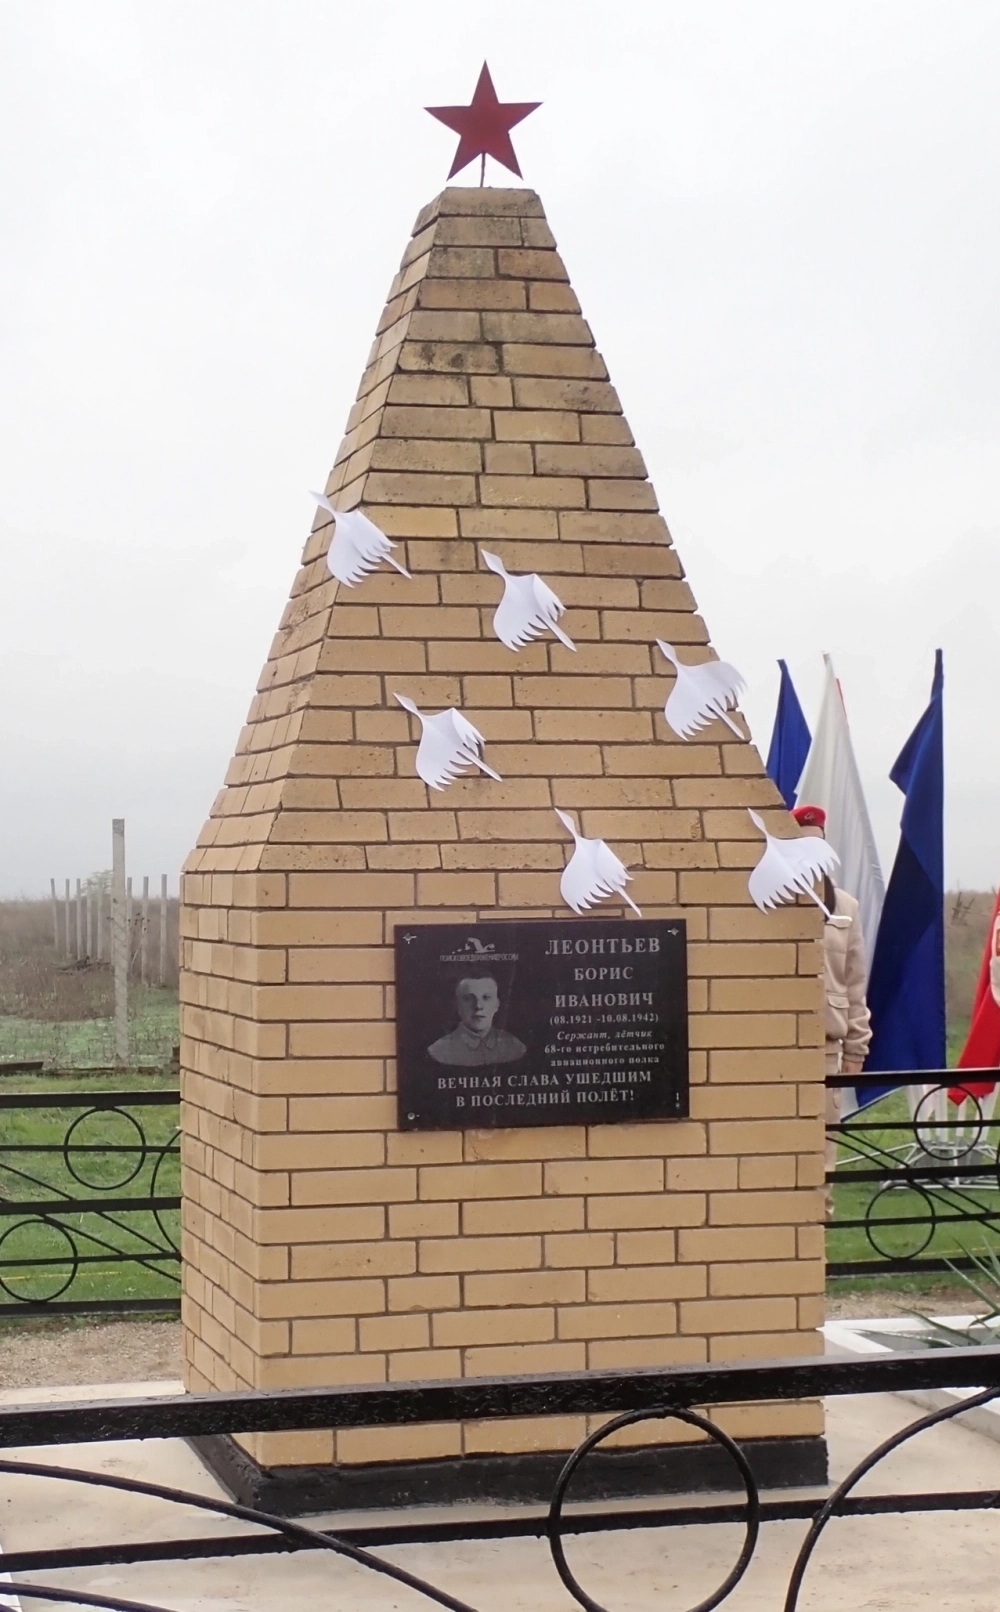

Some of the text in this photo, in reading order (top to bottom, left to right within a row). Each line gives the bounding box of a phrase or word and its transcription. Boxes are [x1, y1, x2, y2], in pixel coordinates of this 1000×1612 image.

[545, 937, 660, 955] ЛЕОНТЬЕВ
[574, 966, 634, 981] БОРИС
[555, 992, 653, 1008] ИВАНОВИЧ
[549, 1014, 592, 1025] (08.1921
[557, 1030, 653, 1042] Сержант, лётчик
[544, 1043, 665, 1055] 68-го истребительного
[550, 1055, 660, 1068] авиационного полка
[437, 1070, 652, 1090] ВЕЧНАЯ СЛАВА УШЕДШИМ
[456, 1088, 635, 1107] В ПОСЛЕДНИЙ ПОЛЁТ!
